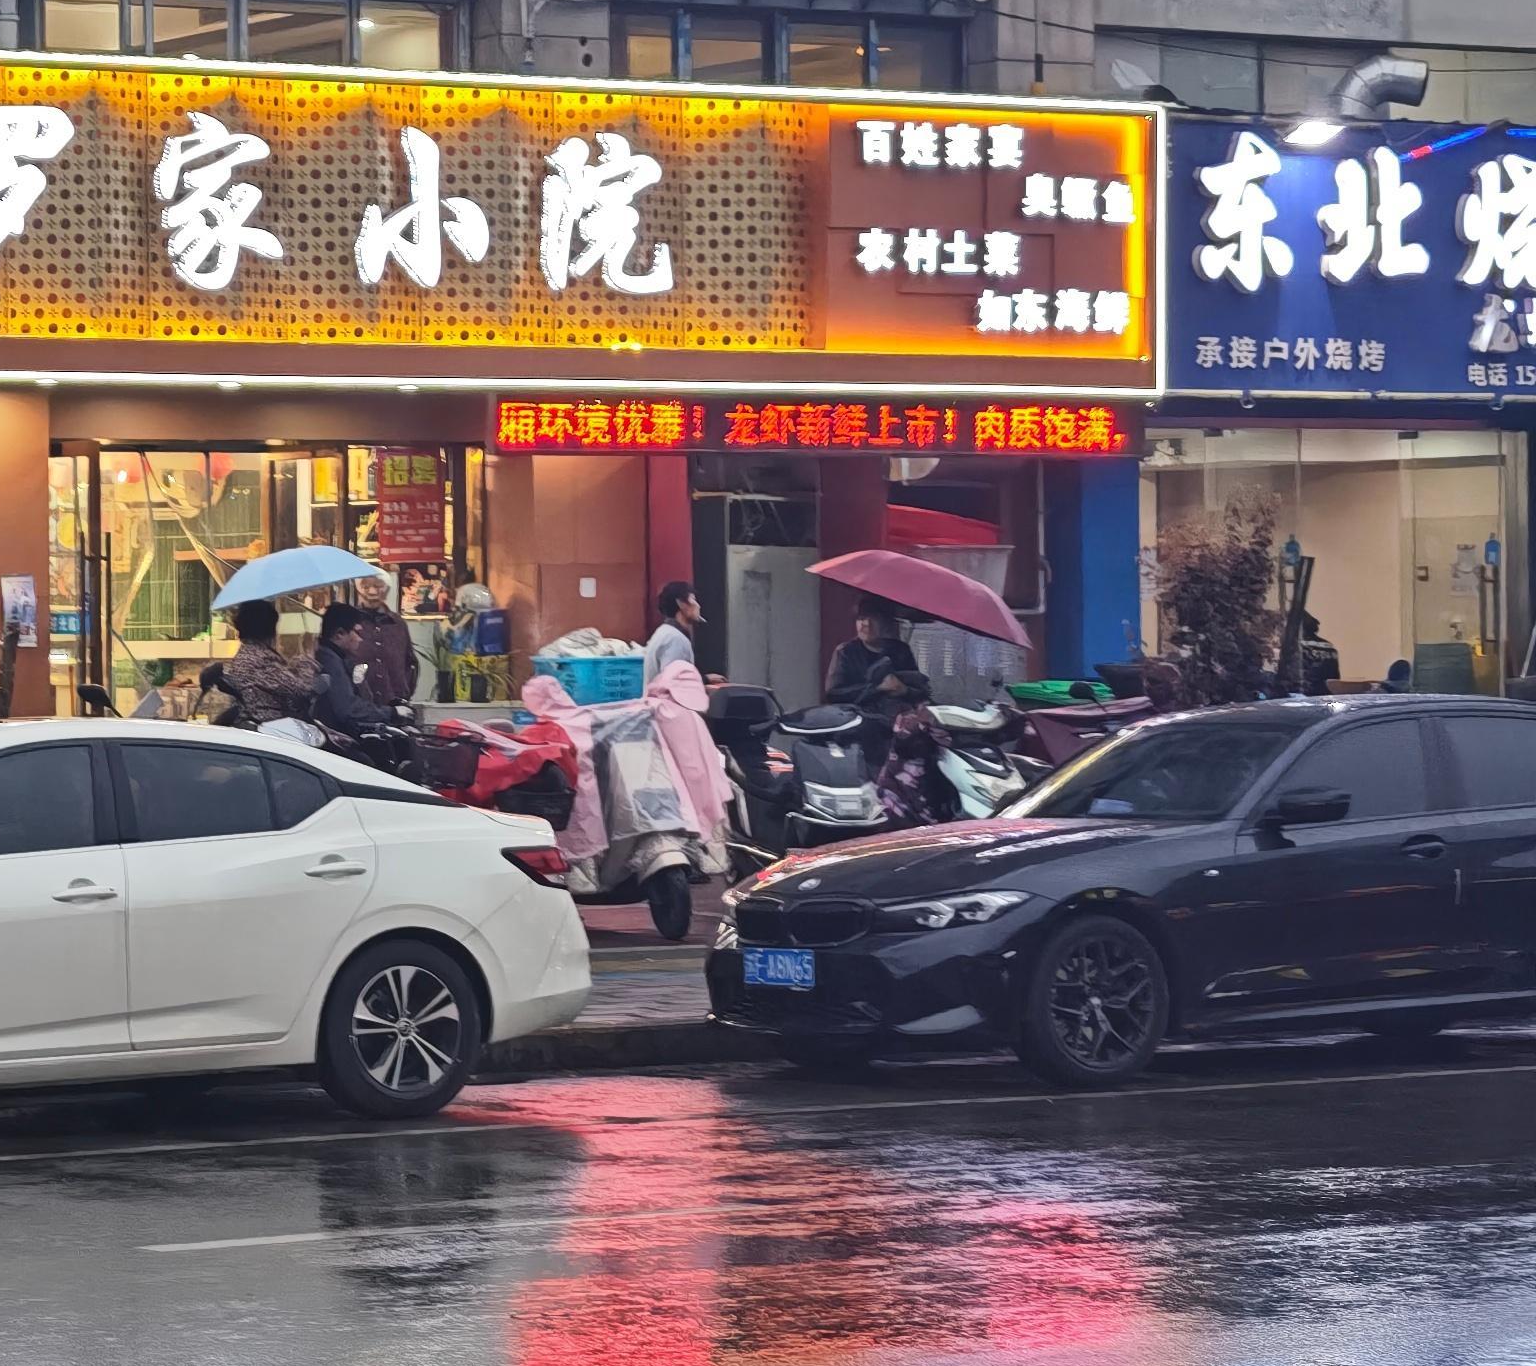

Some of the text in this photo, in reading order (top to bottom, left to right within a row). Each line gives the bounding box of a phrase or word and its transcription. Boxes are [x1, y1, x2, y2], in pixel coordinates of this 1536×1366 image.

[856, 120, 1025, 169] 百姓家宴
[855, 227, 1021, 276] 农村土菜
[975, 288, 1131, 335] 如东海鲜
[1196, 337, 1386, 372] 承接户外烧烤
[1467, 363, 1508, 386] 电话
